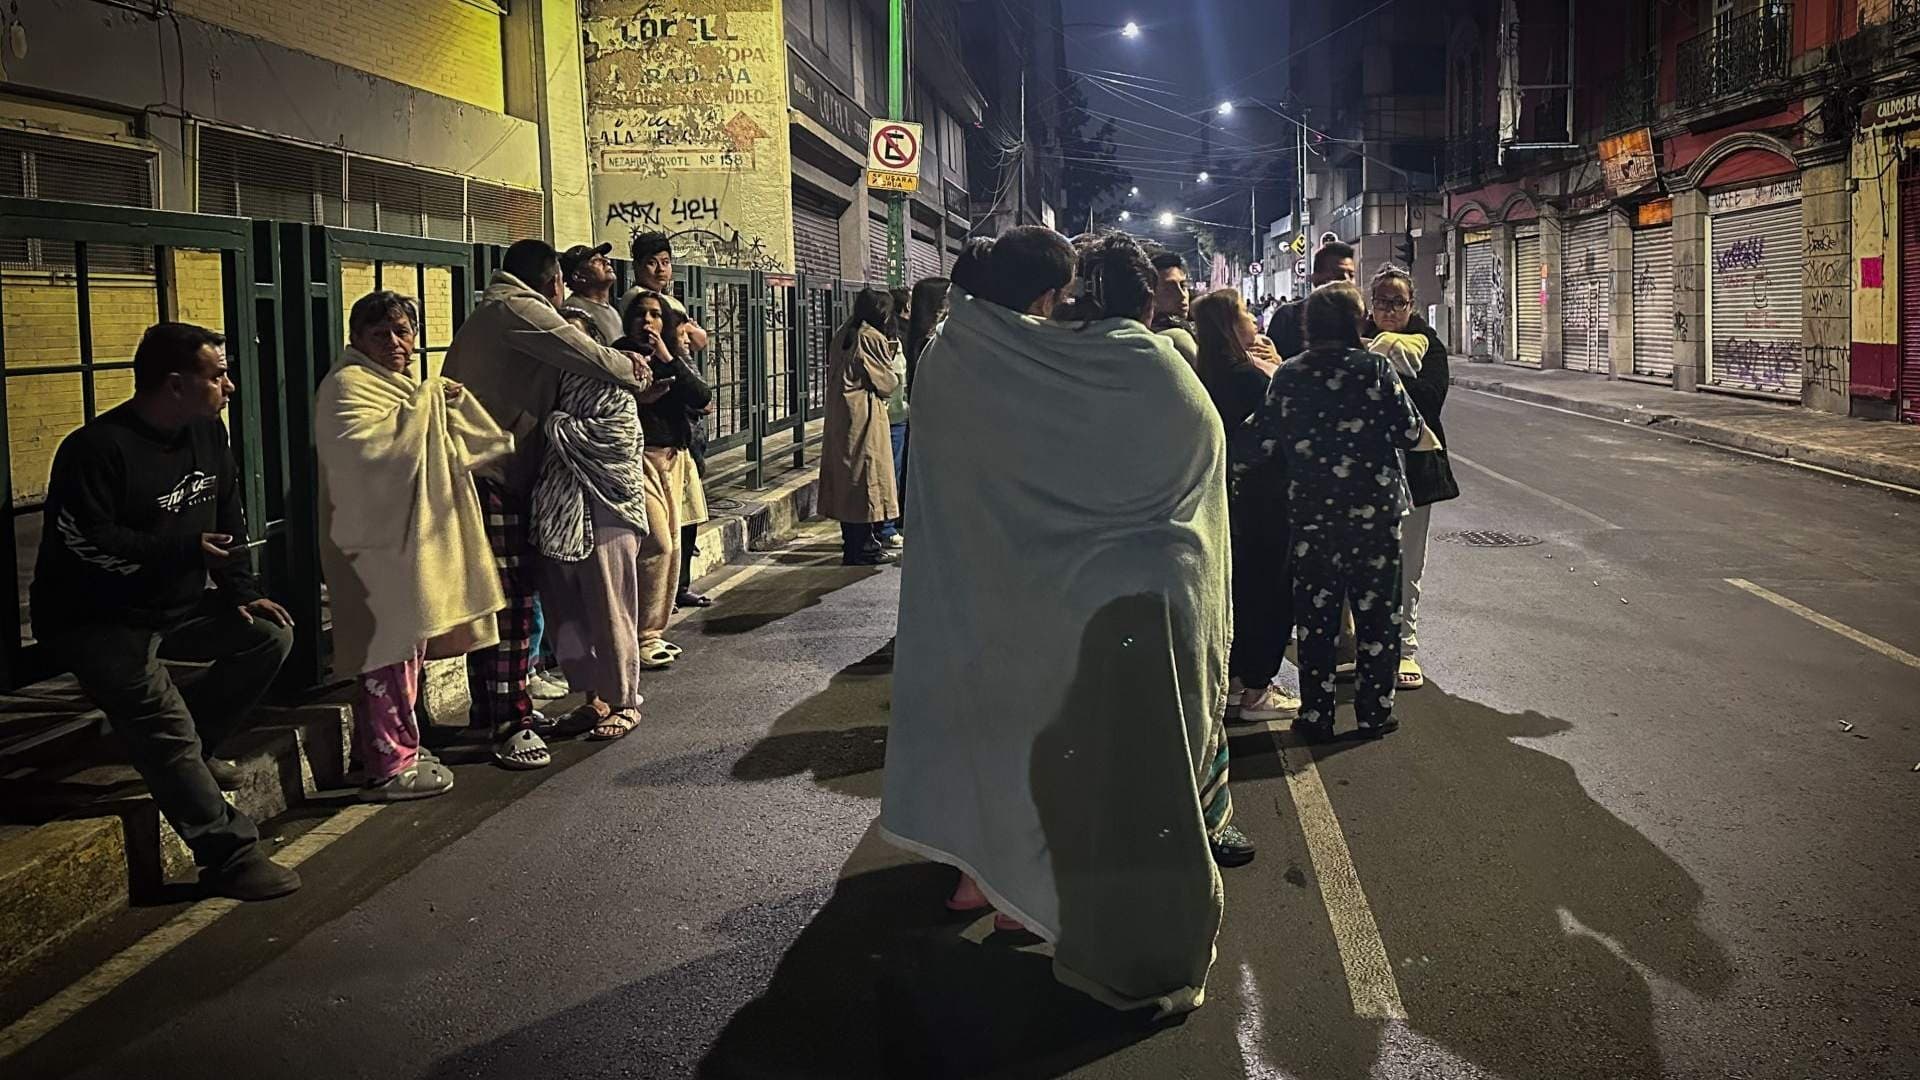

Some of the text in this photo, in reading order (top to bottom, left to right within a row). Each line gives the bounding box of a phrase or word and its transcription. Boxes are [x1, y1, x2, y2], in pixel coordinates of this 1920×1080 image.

[1877, 97, 1906, 118] CALDOS
[1906, 95, 1917, 112] DE
[720, 153, 743, 166] 158
